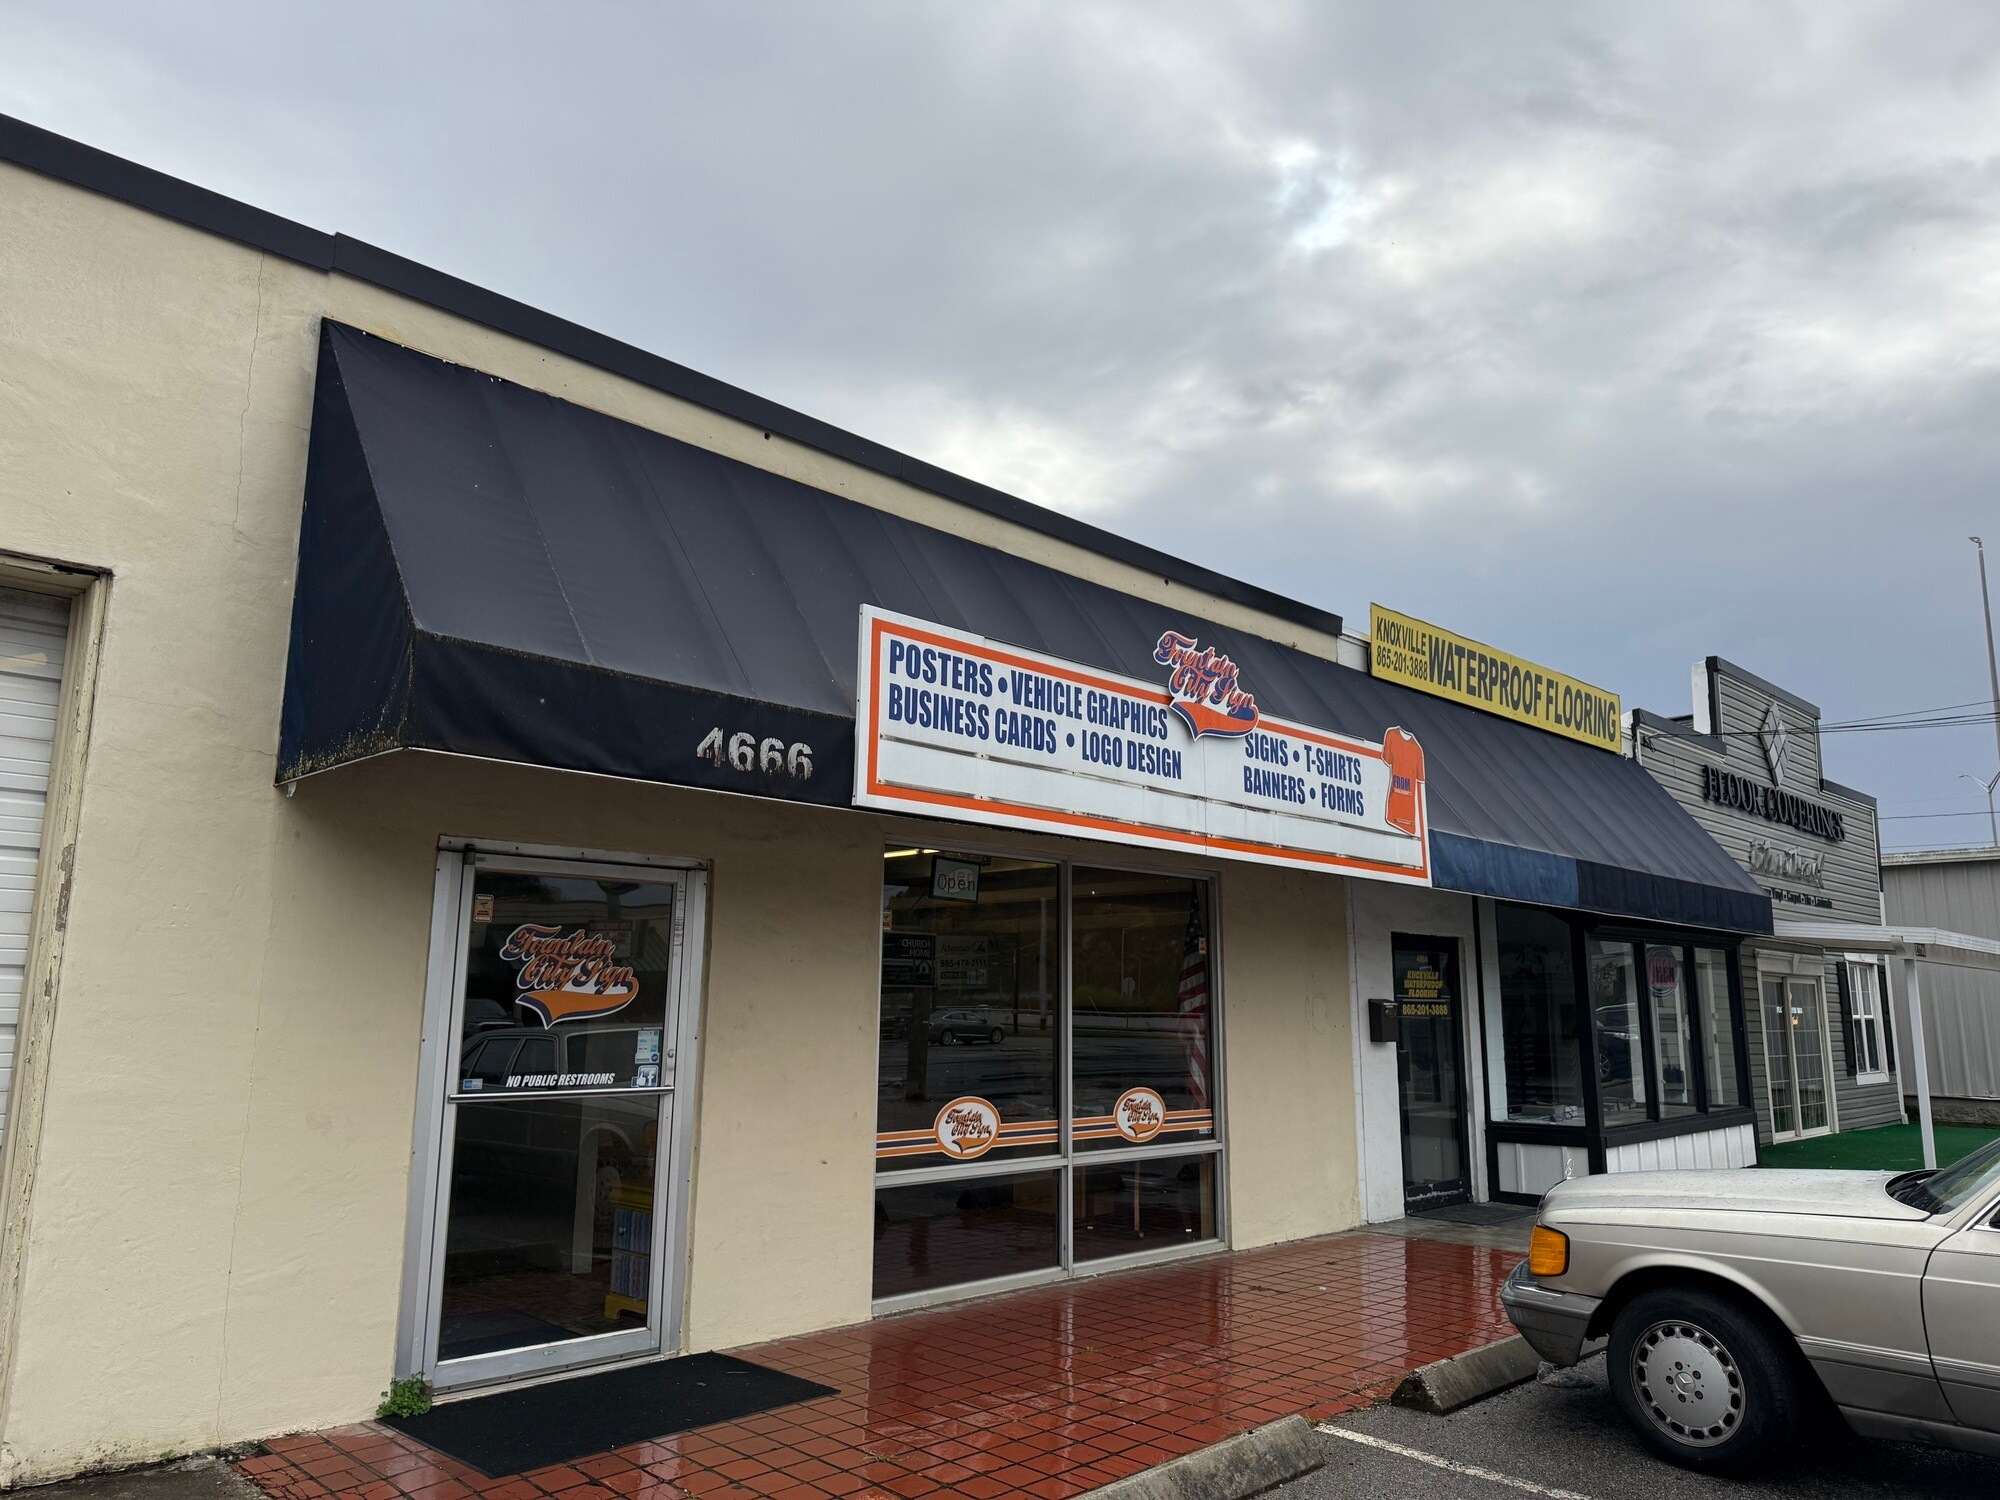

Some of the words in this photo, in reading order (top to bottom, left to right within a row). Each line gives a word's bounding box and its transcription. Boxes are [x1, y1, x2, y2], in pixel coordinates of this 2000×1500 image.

[1376, 616, 1427, 656] KNOXVILLE
[1154, 631, 1238, 679] Fountain
[1376, 647, 1428, 681] 865-201-3888
[889, 639, 993, 697] POSTERS
[1010, 670, 1083, 720] VEHICLE
[1087, 690, 1168, 740] GRAPHICS
[1169, 665, 1217, 704] City
[1210, 675, 1254, 715] Sign
[1428, 634, 1543, 718] WATERPROOF
[1545, 677, 1617, 742] FLOORING
[888, 683, 990, 741] BUSINESS
[995, 708, 1057, 754] CARDS
[1081, 729, 1123, 768] LOGO
[1127, 740, 1182, 780] DESIGN
[696, 726, 814, 780] 4666
[1245, 733, 1289, 767] SIGNS
[1303, 744, 1362, 785] T-SHIRTS
[1243, 765, 1305, 805] BANNERS
[1320, 782, 1364, 817] FORMS
[1393, 775, 1411, 792] FROM
[1702, 765, 1765, 816] FLOOR
[1765, 786, 1846, 842] COVERINGS
[938, 873, 975, 893] Open
[500, 924, 615, 959] Fountain
[902, 939, 931, 948] CHURCH
[909, 949, 931, 958] HOME
[518, 954, 582, 991] City
[572, 955, 634, 994] Sign
[1404, 979, 1444, 990] WATERPROOF
[1407, 970, 1440, 981] KNOXVILLE
[1402, 1003, 1448, 1016] 865-201-3888
[1408, 988, 1439, 999] FLOORING
[505, 1075, 522, 1088] NO
[521, 1074, 558, 1087] PUBLIC
[557, 1072, 616, 1086] RESTROOMS
[945, 1108, 983, 1124] Fountain
